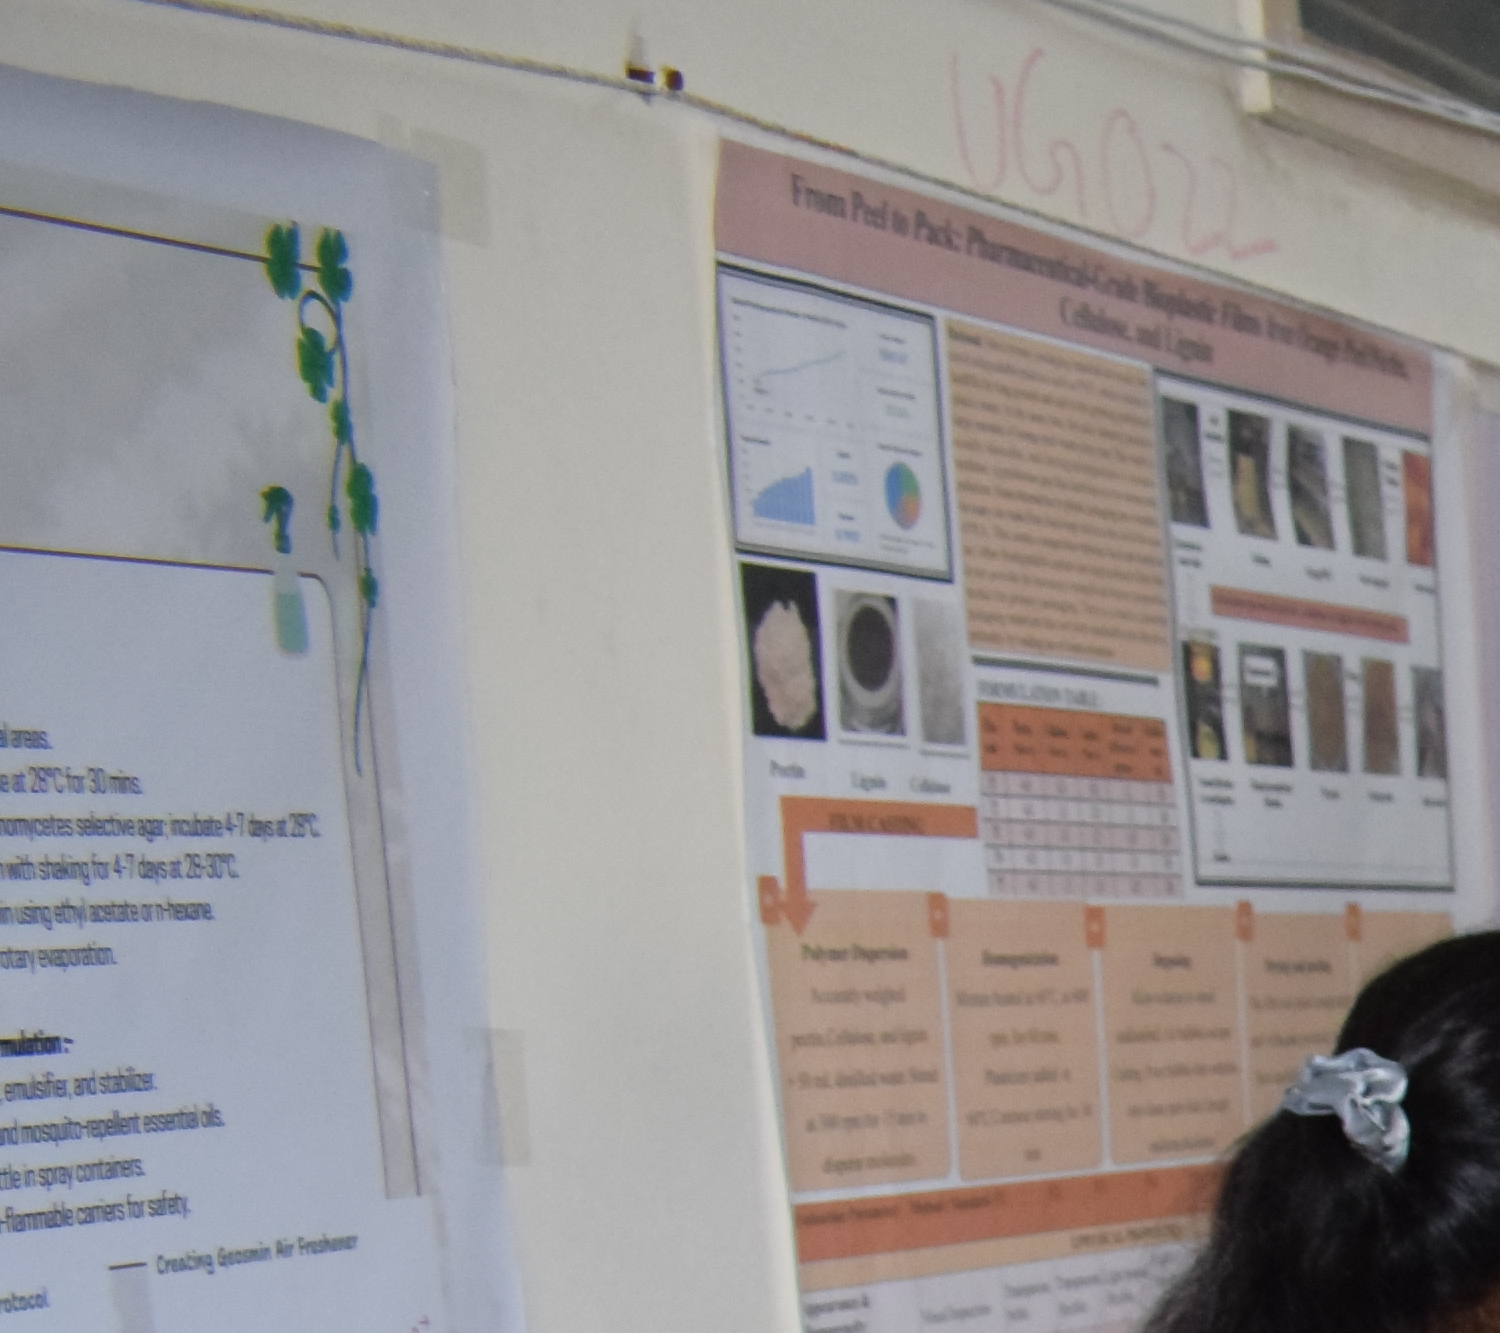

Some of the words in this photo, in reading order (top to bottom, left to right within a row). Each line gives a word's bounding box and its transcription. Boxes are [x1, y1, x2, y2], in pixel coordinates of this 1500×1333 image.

[12, 728, 52, 750] areas.
[13, 770, 26, 793] at
[65, 766, 84, 793] for
[88, 767, 106, 794] 30
[110, 769, 143, 795] mins.
[76, 811, 135, 837] selective
[170, 812, 223, 838] incubate
[225, 811, 244, 837] 4-7
[248, 811, 274, 842] days
[277, 816, 287, 838] at
[8, 855, 35, 880] with
[39, 853, 90, 885] shaking
[92, 853, 110, 880] for
[113, 853, 135, 879] 4-7
[138, 852, 167, 885] days
[170, 859, 182, 879] at
[17, 900, 52, 931] using
[54, 898, 86, 929] ethyl
[89, 899, 138, 923] acetate
[141, 903, 153, 922] or
[155, 896, 215, 921] n-hexane.
[0, 946, 35, 974] otary
[38, 941, 117, 973] evaporation.
[4, 1070, 71, 1102] emulsifier,
[74, 1070, 97, 1097] and
[99, 1066, 158, 1095] stabilizer.
[21, 1109, 141, 1148] mosquito-repellent
[143, 1104, 199, 1134] essential
[201, 1102, 225, 1128] oils.
[24, 1163, 36, 1188] in
[38, 1164, 73, 1190] spray
[76, 1155, 145, 1184] containers.
[77, 1198, 125, 1225] carriers
[127, 1193, 145, 1220] for
[147, 1189, 191, 1219] safety.
[157, 1249, 215, 1275] Creating
[217, 1241, 272, 1268] Geosmin
[276, 1237, 294, 1259] Air
